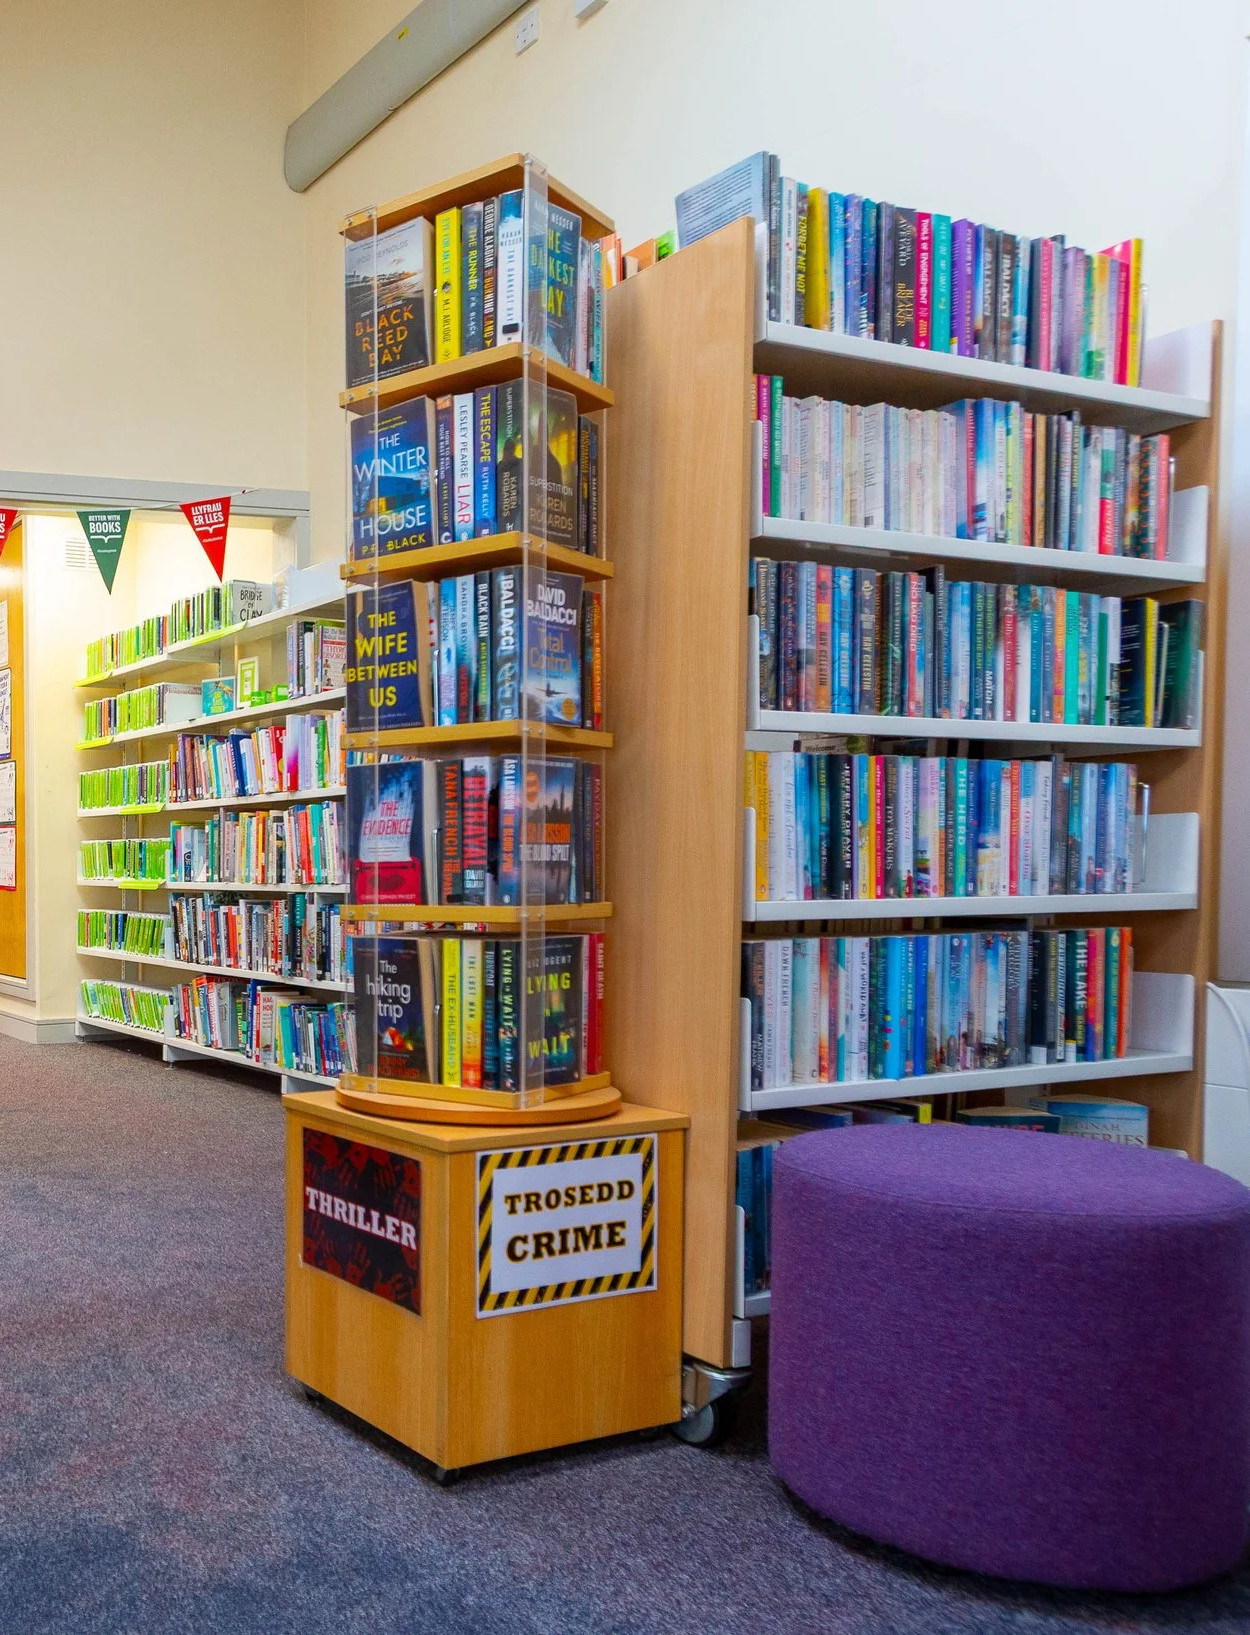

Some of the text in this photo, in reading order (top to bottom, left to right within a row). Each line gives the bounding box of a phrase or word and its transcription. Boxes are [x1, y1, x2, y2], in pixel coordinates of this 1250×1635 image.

[484, 203, 495, 234] GEORGE
[797, 215, 808, 295] FORGET ME NOT
[899, 218, 907, 267] AVEYARD
[919, 218, 930, 304] TOOLS ENGAGEMENT
[468, 228, 478, 336] THE RUNNER BLACK
[483, 276, 494, 314] BURNING
[354, 304, 415, 337] BLACK
[897, 282, 906, 328] BREAKER
[906, 288, 914, 322] BLADE
[361, 326, 408, 352] REED
[483, 314, 493, 337] LAND
[369, 344, 404, 369] BAY
[480, 393, 491, 417] THE
[506, 387, 514, 438] SUPERSTITION
[379, 432, 401, 451] THE
[479, 418, 491, 463] ESCAPE
[354, 446, 427, 482] WINTER
[457, 404, 471, 524] LESLEY PEARSE LIAR
[191, 502, 222, 516] LLYFRAU
[510, 476, 518, 509] KAREN
[89, 521, 121, 533] BOOKS
[193, 511, 224, 526] ER LLES
[359, 504, 426, 539] HOUSE
[386, 532, 426, 552] BLACK
[537, 584, 566, 606] DAVID
[911, 581, 918, 598] NO
[368, 610, 397, 629] THE
[479, 583, 489, 638] BLACK RAIN
[501, 580, 515, 651] BALDACCI
[527, 599, 578, 626] BALDACCI
[355, 632, 408, 659] WIFE
[818, 631, 828, 686] RAY CELESTIN
[840, 632, 849, 687] RAY CELESTIN
[346, 659, 418, 683] BETWEEN
[863, 636, 872, 690] RAY CELESTIN
[369, 684, 398, 708] US
[985, 670, 994, 705] MATCH
[503, 776, 516, 810] LARSSON
[844, 763, 852, 817] JEFFERY
[380, 801, 400, 818] THE
[445, 764, 459, 856] TANA FRENCH
[463, 775, 488, 869] BETRAYAL
[903, 806, 912, 840] Secret
[957, 768, 967, 846] THE HERD
[362, 818, 413, 837] EVIDENCE
[452, 859, 461, 874] THE
[1023, 837, 1031, 880] Sharing
[379, 960, 398, 974] The
[485, 950, 495, 987] TURNCOAT
[782, 945, 790, 970] DAWN
[1076, 939, 1088, 968] THE
[365, 974, 411, 1004] hiking
[469, 976, 477, 996] LOST
[505, 948, 515, 1028] LYING WAIT
[526, 971, 571, 995] LYING
[859, 973, 867, 1001] WORLD
[1076, 971, 1088, 1010] LAKE
[377, 999, 404, 1024] trip
[528, 1031, 571, 1060] WAIT
[1075, 1122, 1120, 1132] DINAH
[505, 1179, 636, 1216] TROSEDD
[305, 1186, 417, 1251] THRILLER
[506, 1220, 628, 1264] CRIME
